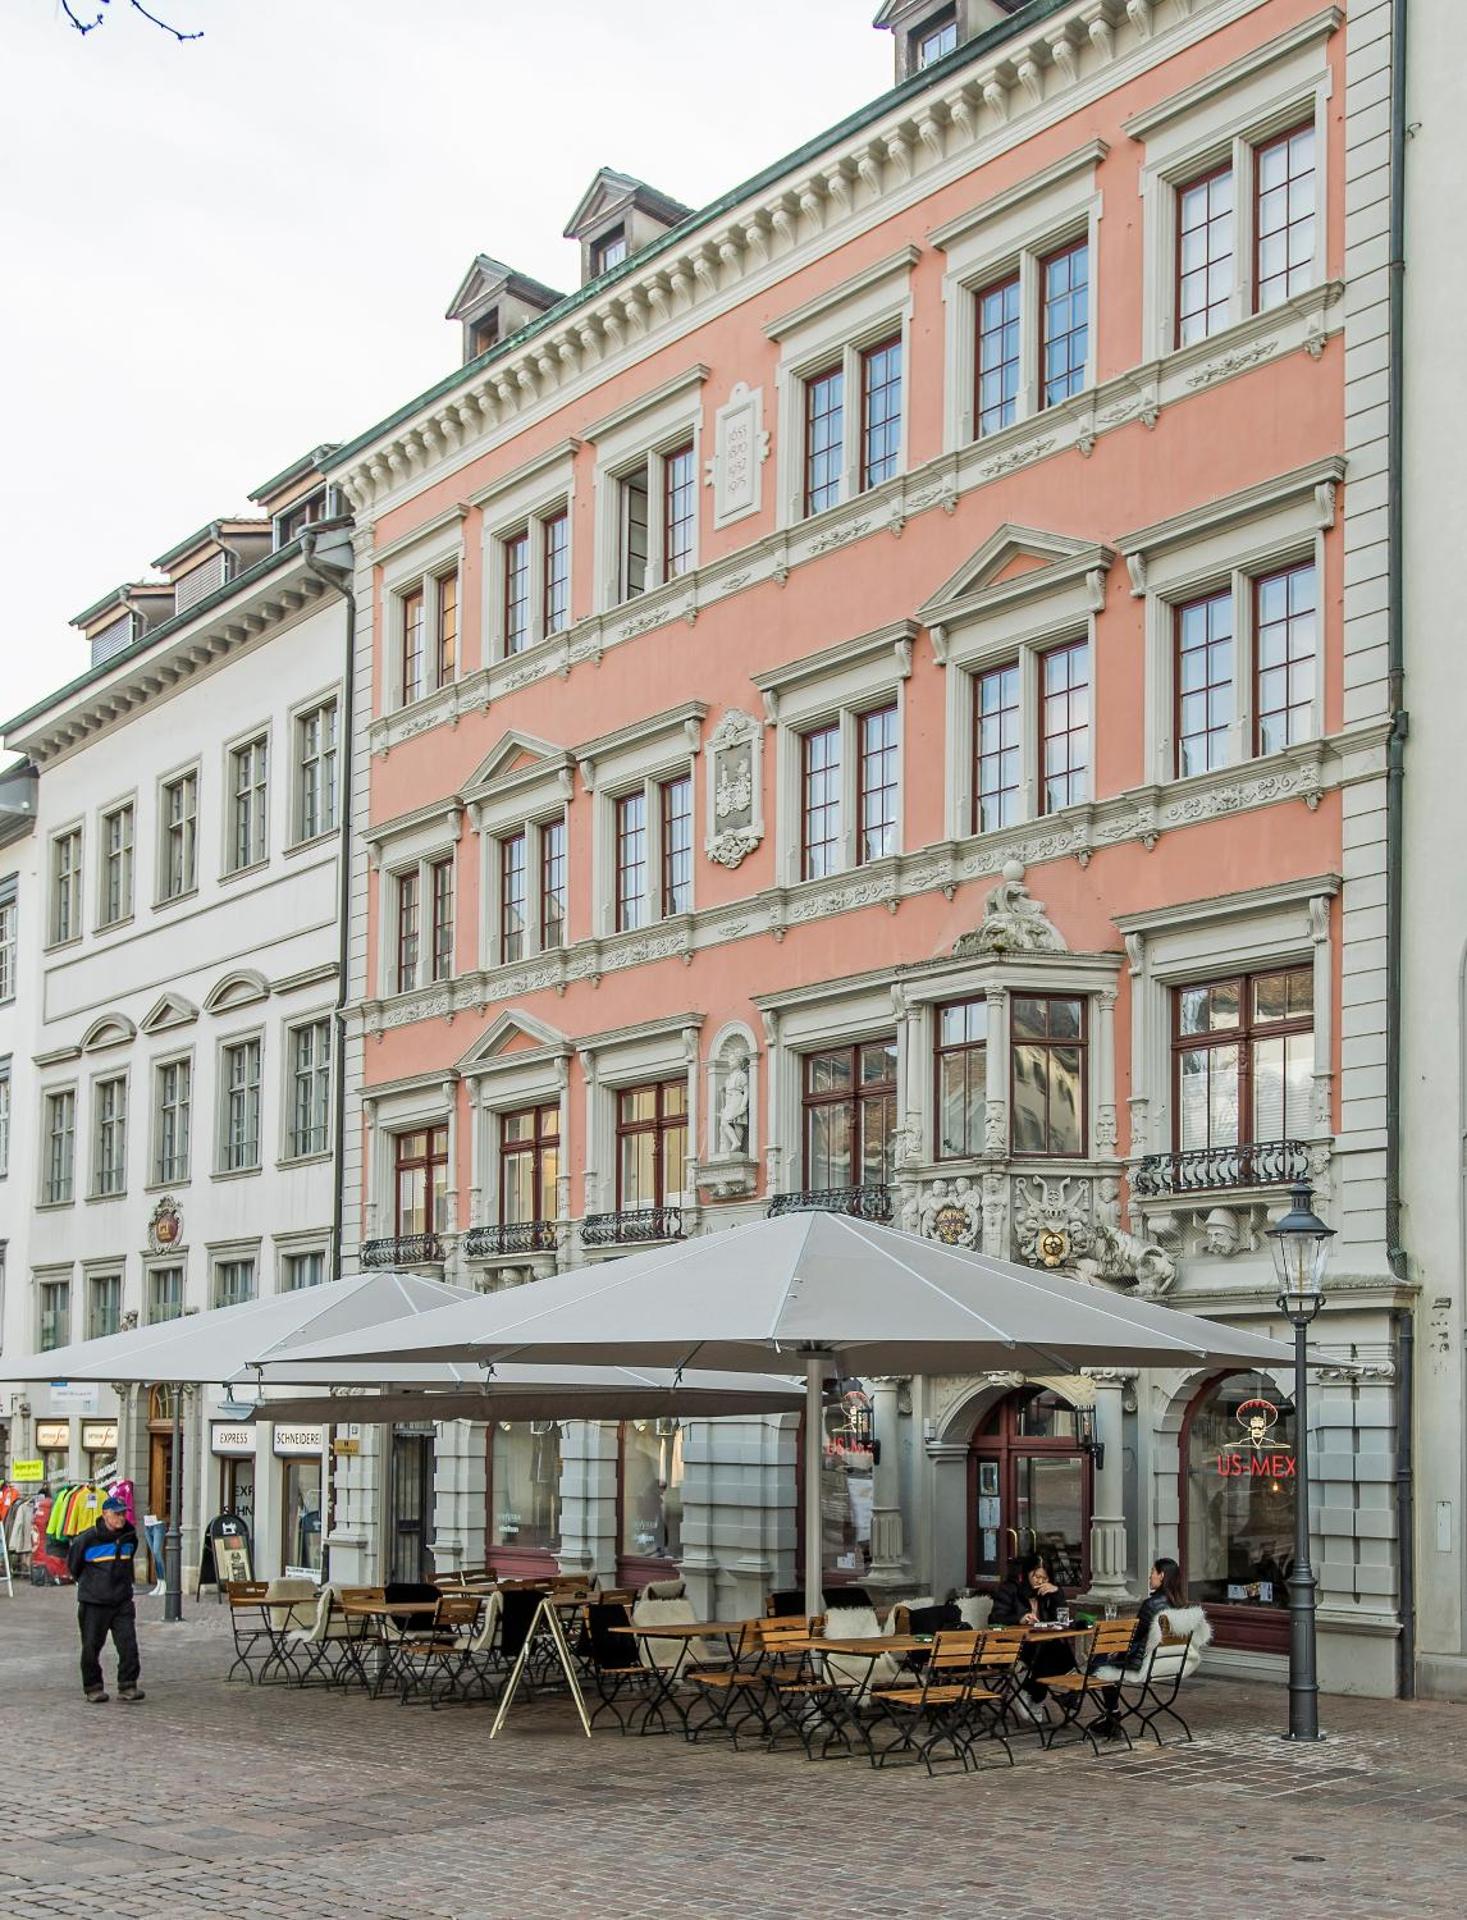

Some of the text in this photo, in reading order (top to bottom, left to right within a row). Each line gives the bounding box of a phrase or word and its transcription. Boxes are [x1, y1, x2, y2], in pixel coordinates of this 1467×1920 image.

[219, 1432, 322, 1446] EXPRESS SCHNEIDEREI
[1217, 1454, 1296, 1478] US-MEX
